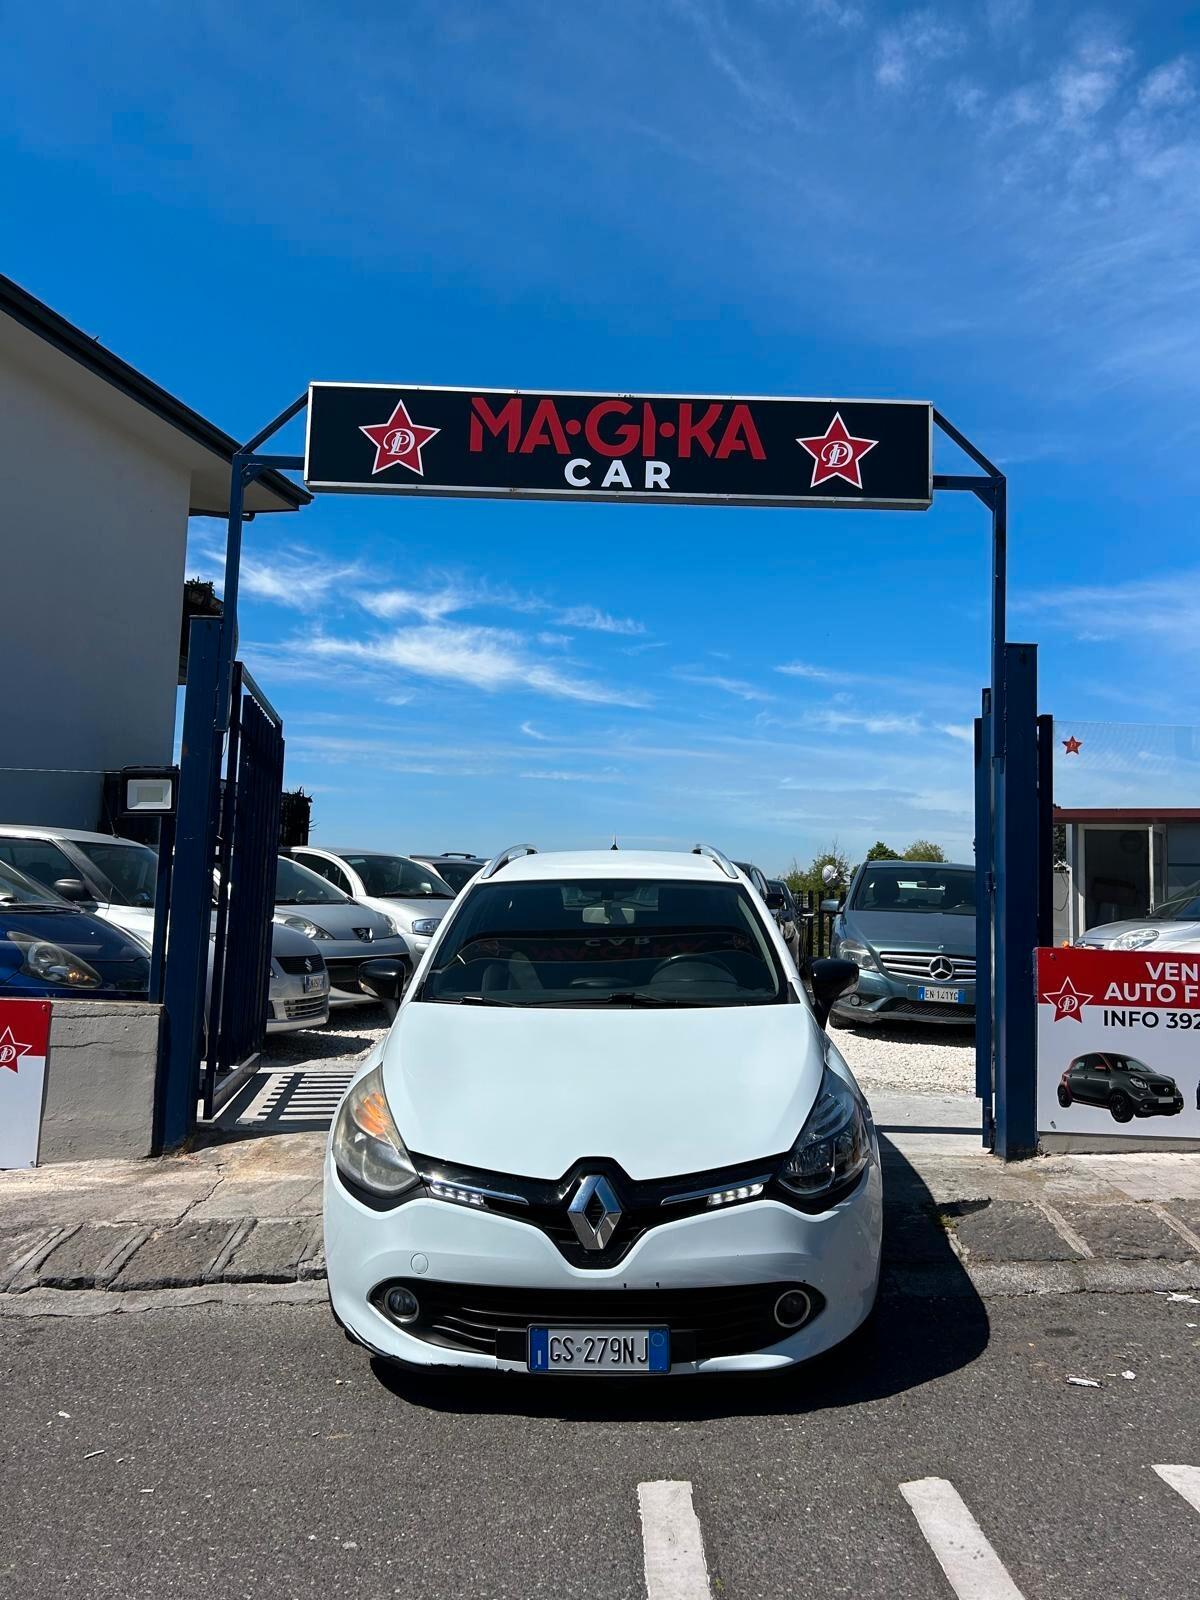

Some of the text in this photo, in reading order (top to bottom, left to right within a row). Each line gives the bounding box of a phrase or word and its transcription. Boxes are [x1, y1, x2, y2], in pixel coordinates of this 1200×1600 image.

[564, 458, 671, 489] CAR
[1145, 962, 1199, 982] VEN
[1104, 982, 1177, 1003] AUTO
[1104, 1010, 1160, 1029] INFO
